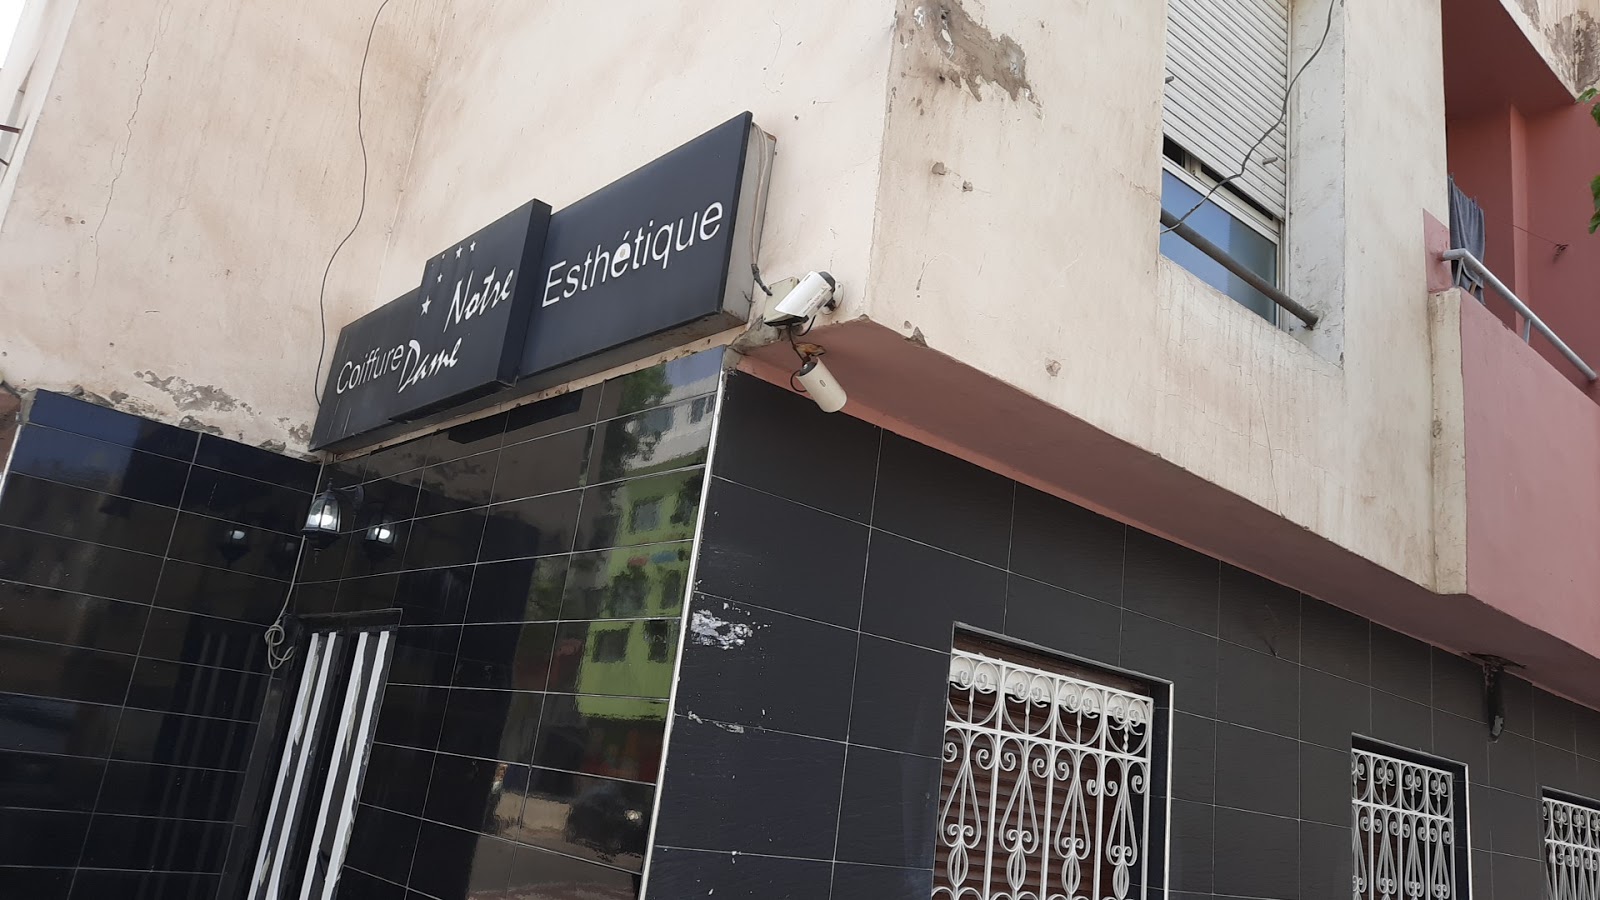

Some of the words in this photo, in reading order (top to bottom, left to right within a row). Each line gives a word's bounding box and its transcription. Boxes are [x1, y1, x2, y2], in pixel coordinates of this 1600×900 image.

[542, 201, 724, 308] Esthétique
[443, 266, 514, 333] Notre
[336, 344, 405, 394] Coiffure
[397, 337, 462, 394] Dame
